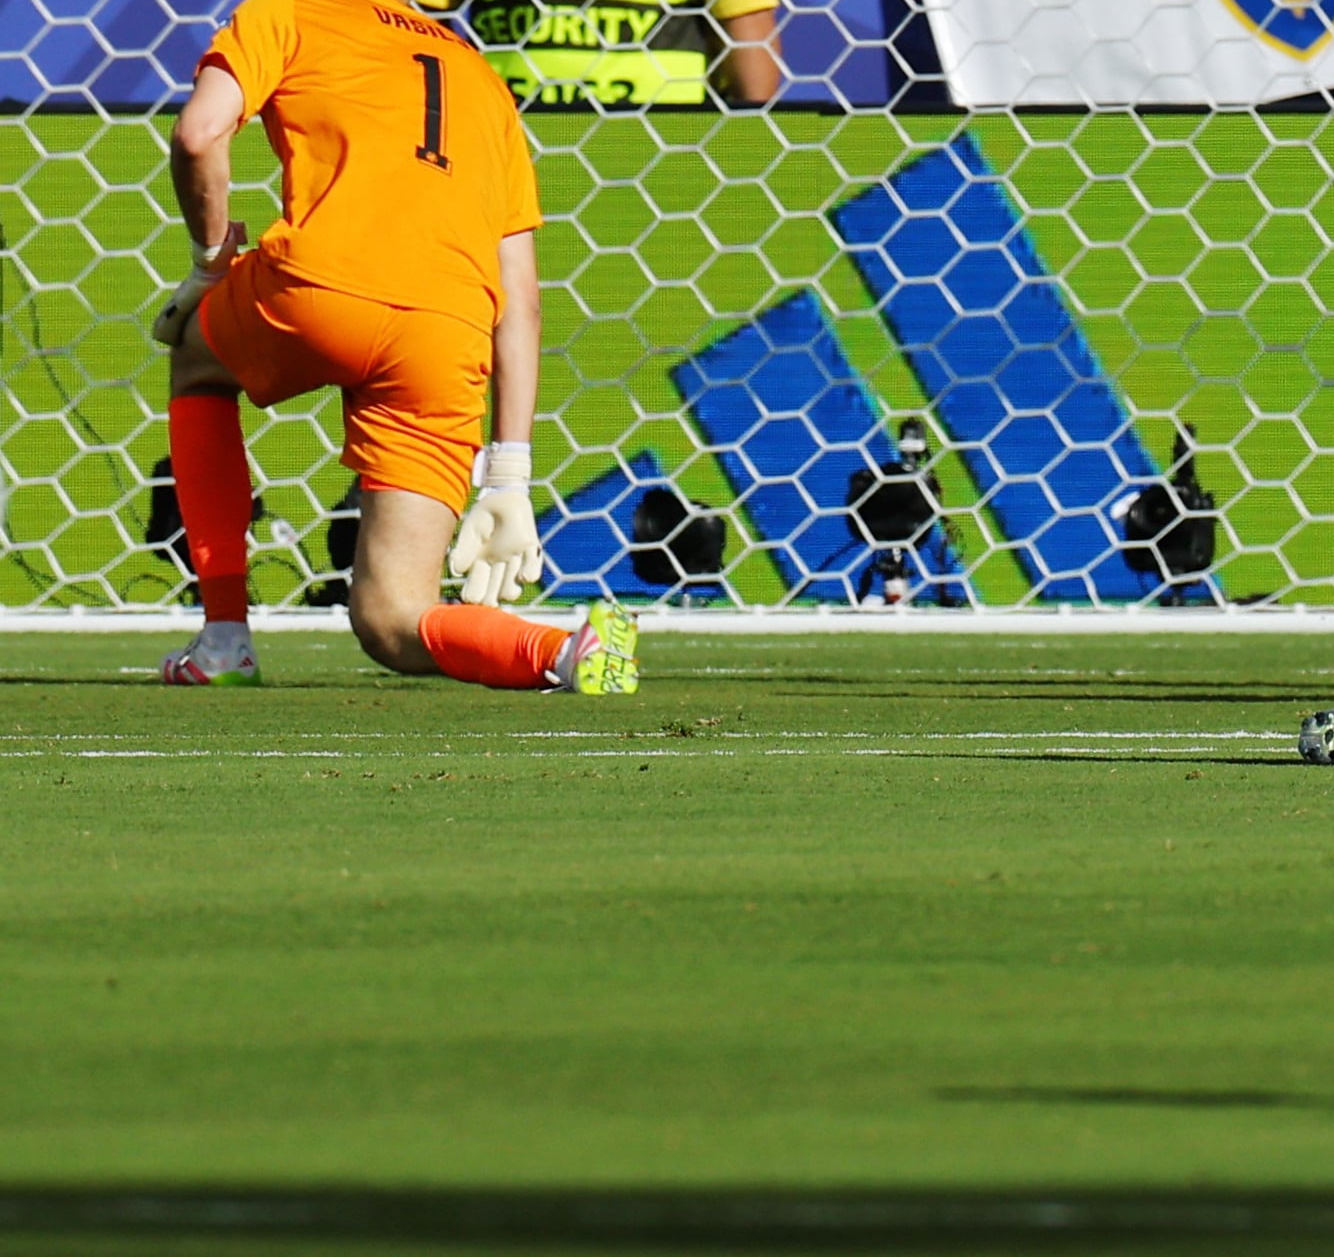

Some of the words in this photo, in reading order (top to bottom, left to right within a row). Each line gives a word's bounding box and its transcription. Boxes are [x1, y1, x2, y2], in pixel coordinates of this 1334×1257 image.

[372, 5, 471, 51] VASIL
[472, 4, 660, 47] SECURITY
[411, 52, 453, 178] 1
